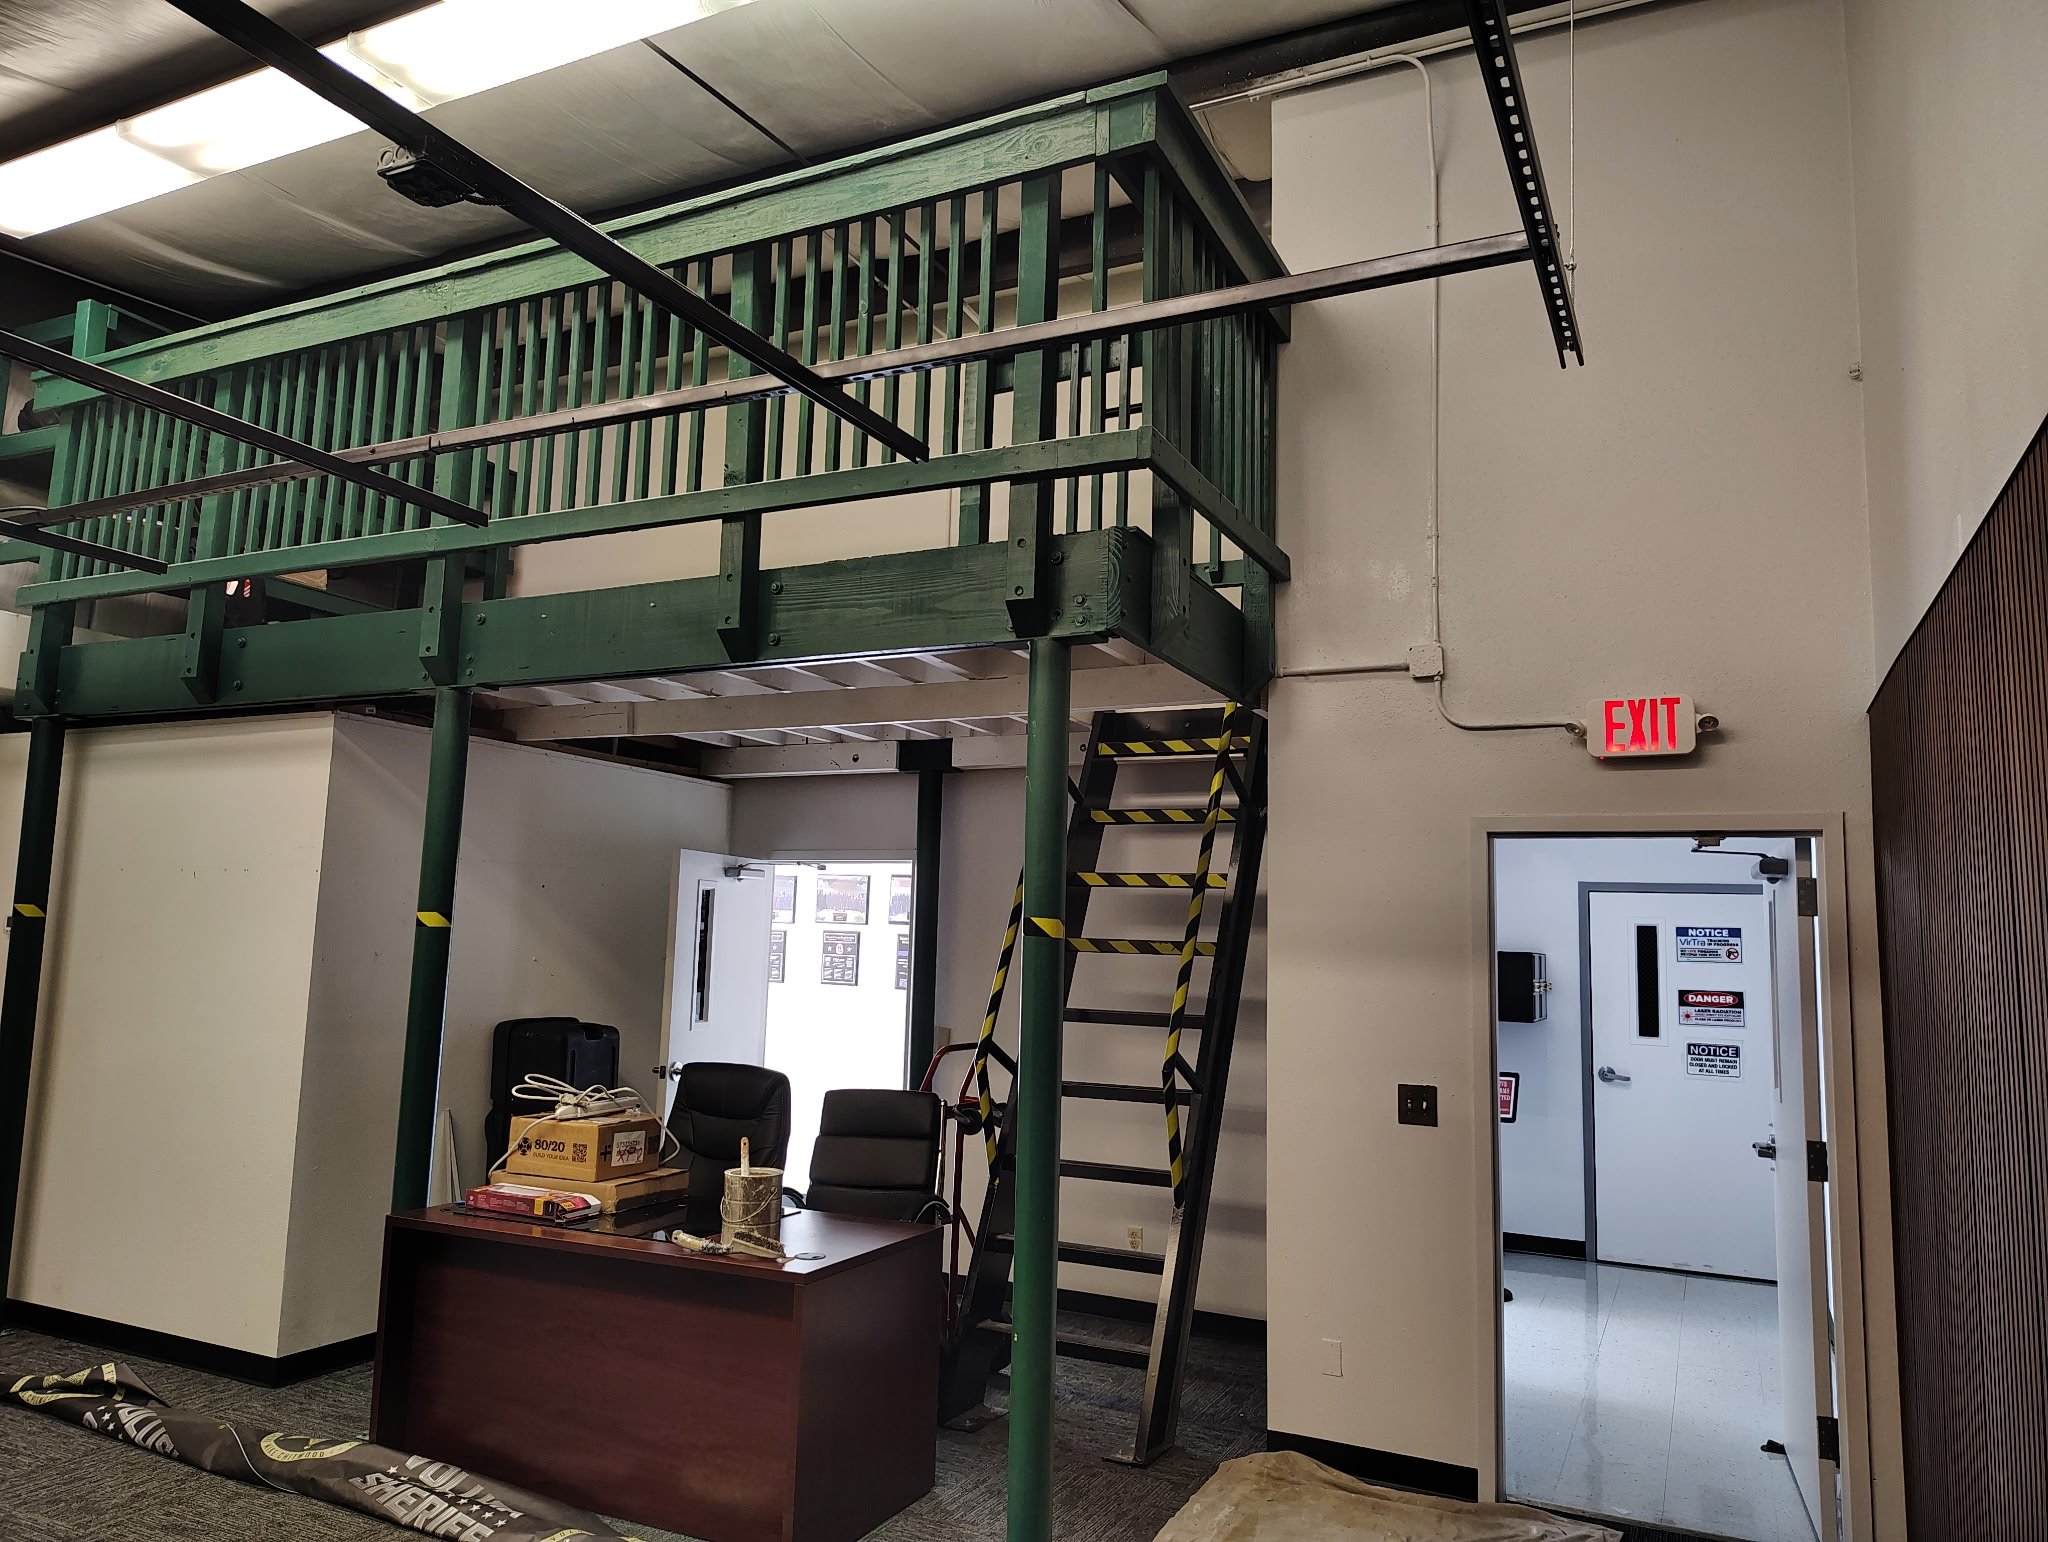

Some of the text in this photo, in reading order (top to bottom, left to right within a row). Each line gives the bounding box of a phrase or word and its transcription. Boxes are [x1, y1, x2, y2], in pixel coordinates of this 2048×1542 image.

[1604, 697, 1681, 752] EXIT
[1680, 938, 1705, 946] VirTra
[1688, 995, 1733, 1003] DANGER
[1691, 1046, 1736, 1056] NOTICE
[534, 1139, 566, 1153] 80/20
[546, 1152, 559, 1160] YOUR
[263, 1443, 325, 1460] MIKE CHITWOOD
